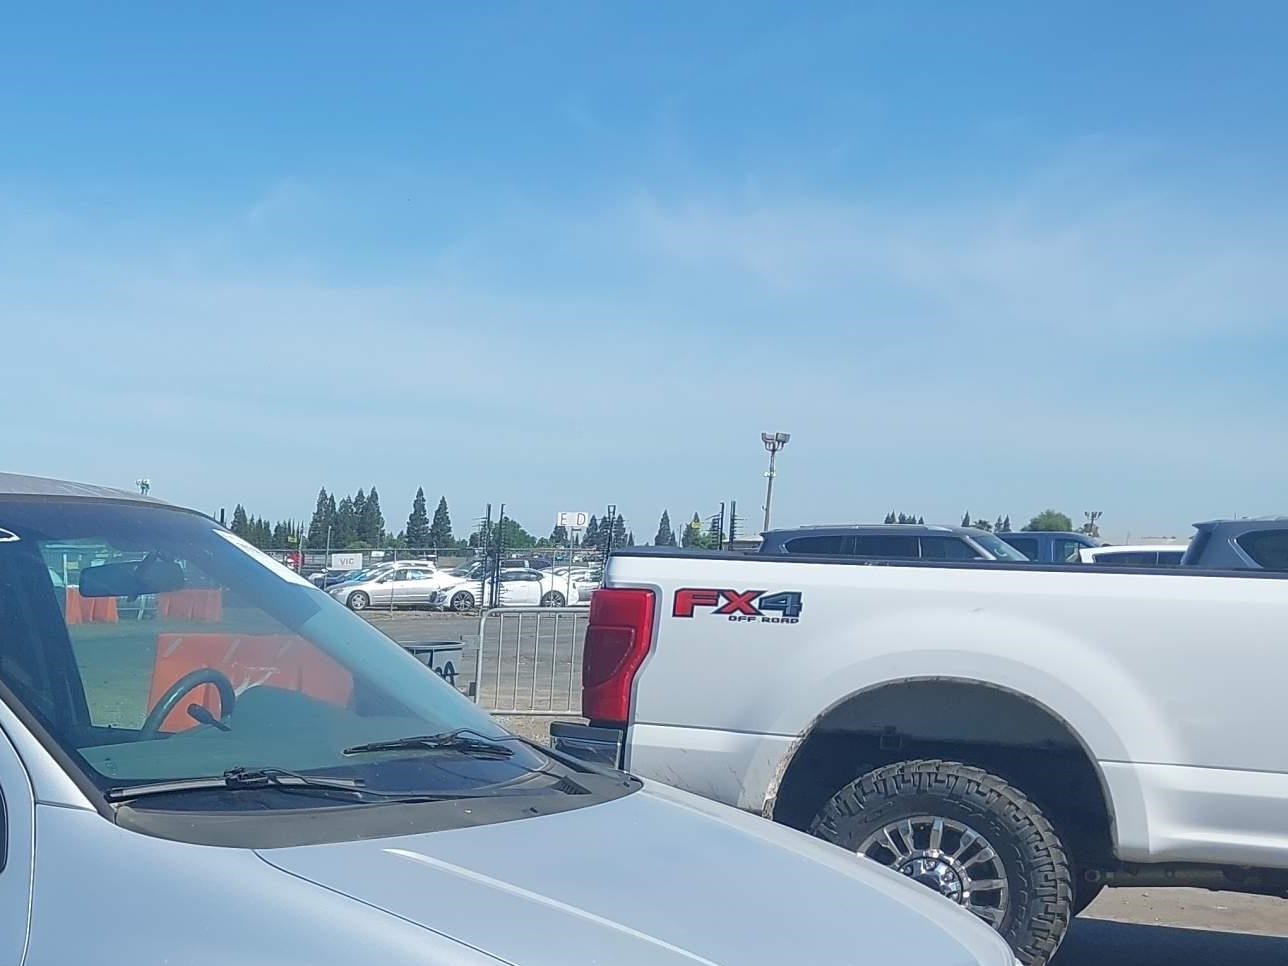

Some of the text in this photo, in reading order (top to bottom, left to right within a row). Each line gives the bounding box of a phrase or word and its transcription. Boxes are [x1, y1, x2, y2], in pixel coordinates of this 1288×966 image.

[560, 512, 586, 526] E D
[671, 587, 804, 618] FX4
[728, 615, 800, 625] OFF ROAD
